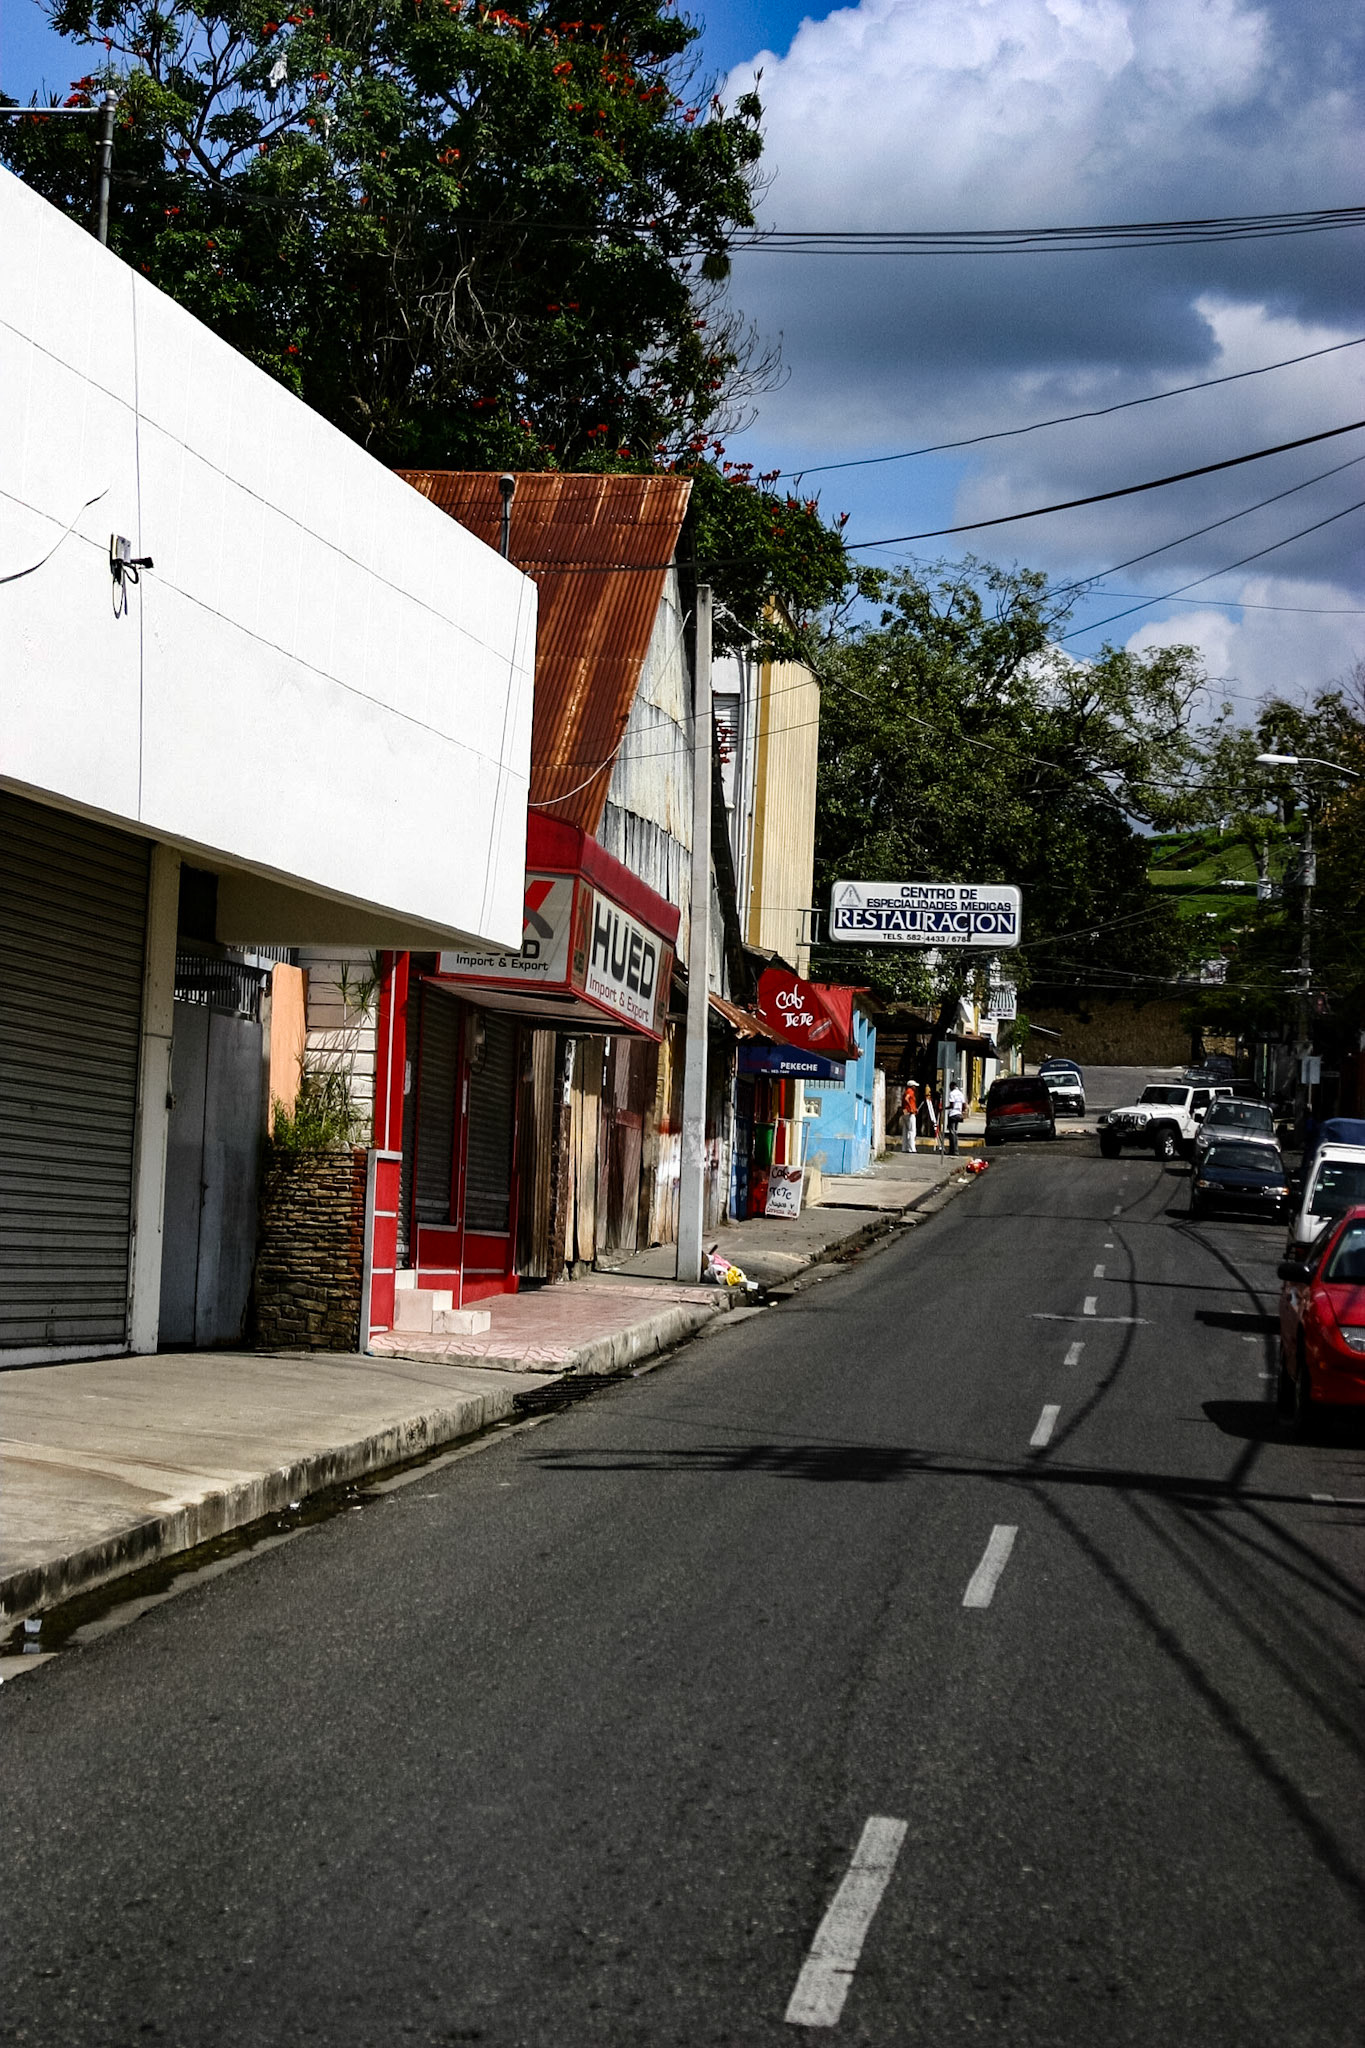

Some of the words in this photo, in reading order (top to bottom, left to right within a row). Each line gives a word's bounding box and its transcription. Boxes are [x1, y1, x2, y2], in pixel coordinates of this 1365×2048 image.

[901, 886, 955, 900] CENTRO
[960, 888, 978, 900] DE
[867, 898, 957, 910] ESPECIALIDADES
[961, 901, 1012, 911] MEDICAS
[837, 909, 1015, 933] RESTAURACION
[591, 901, 656, 1000] HUED
[457, 954, 494, 968] Import
[498, 957, 507, 968] &
[511, 958, 549, 972] Export
[589, 973, 617, 1003] Import
[627, 996, 650, 1023] Export
[780, 1061, 818, 1072] PEKECHE
